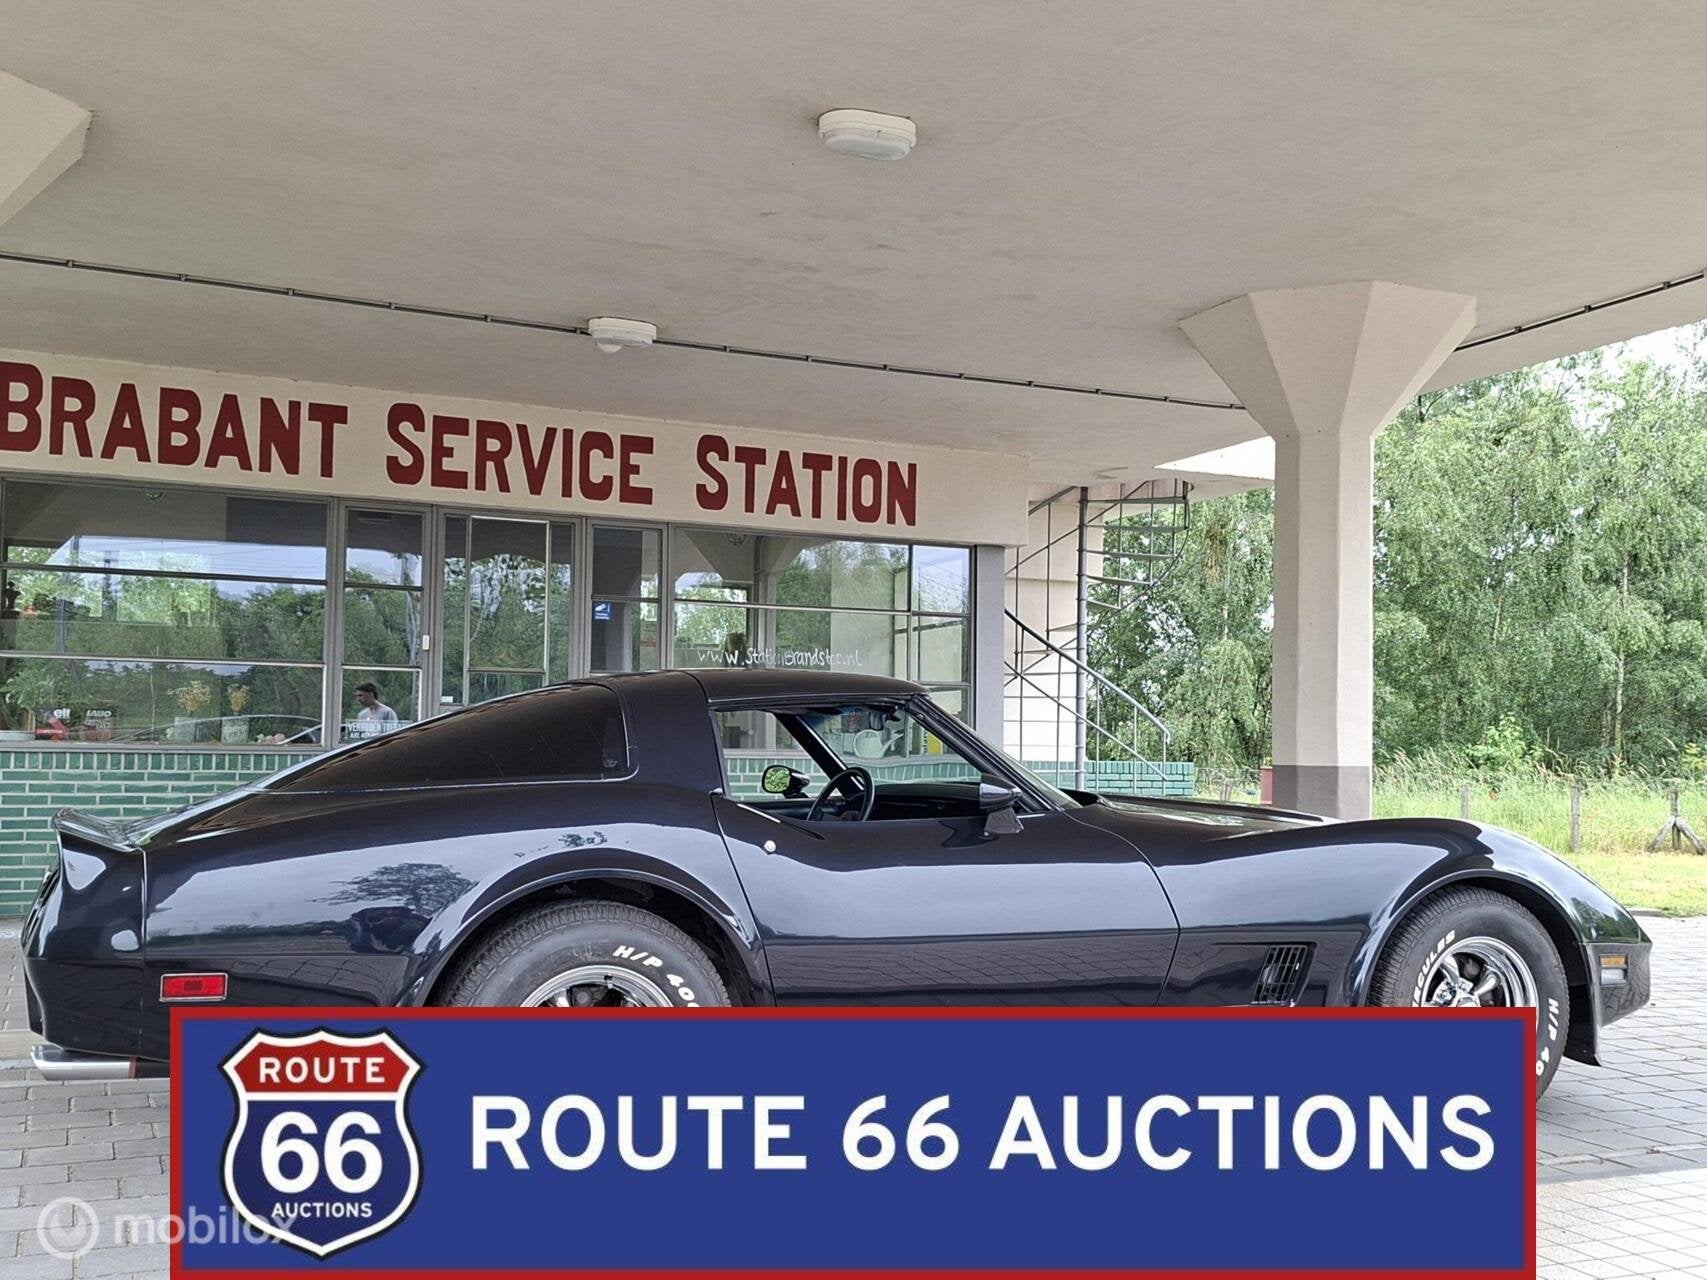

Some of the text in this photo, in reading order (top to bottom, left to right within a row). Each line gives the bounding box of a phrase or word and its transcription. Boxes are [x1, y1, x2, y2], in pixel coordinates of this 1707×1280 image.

[0, 361, 918, 526] BRABANT SERVICE STATION
[612, 945, 663, 967] H/P
[1548, 998, 1559, 1040] H/P
